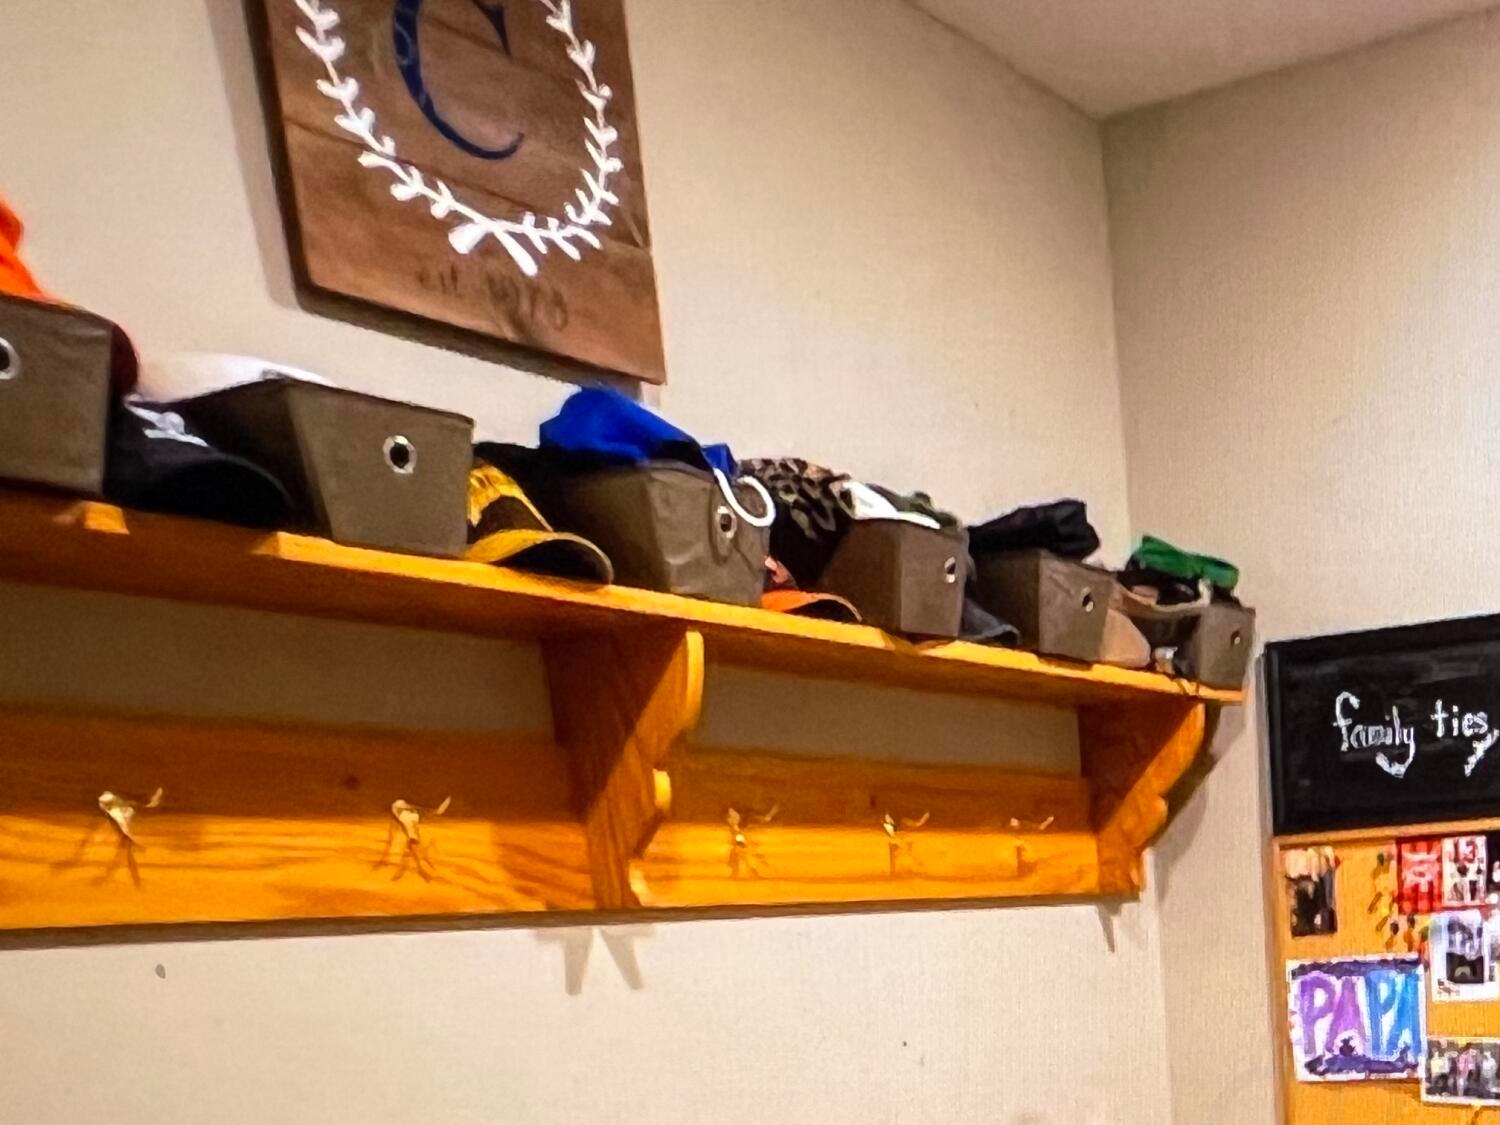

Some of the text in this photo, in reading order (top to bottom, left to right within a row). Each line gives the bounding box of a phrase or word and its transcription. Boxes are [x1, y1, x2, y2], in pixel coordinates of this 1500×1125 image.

[1333, 691, 1500, 779] family ties
[1299, 968, 1422, 1057] PAPA
